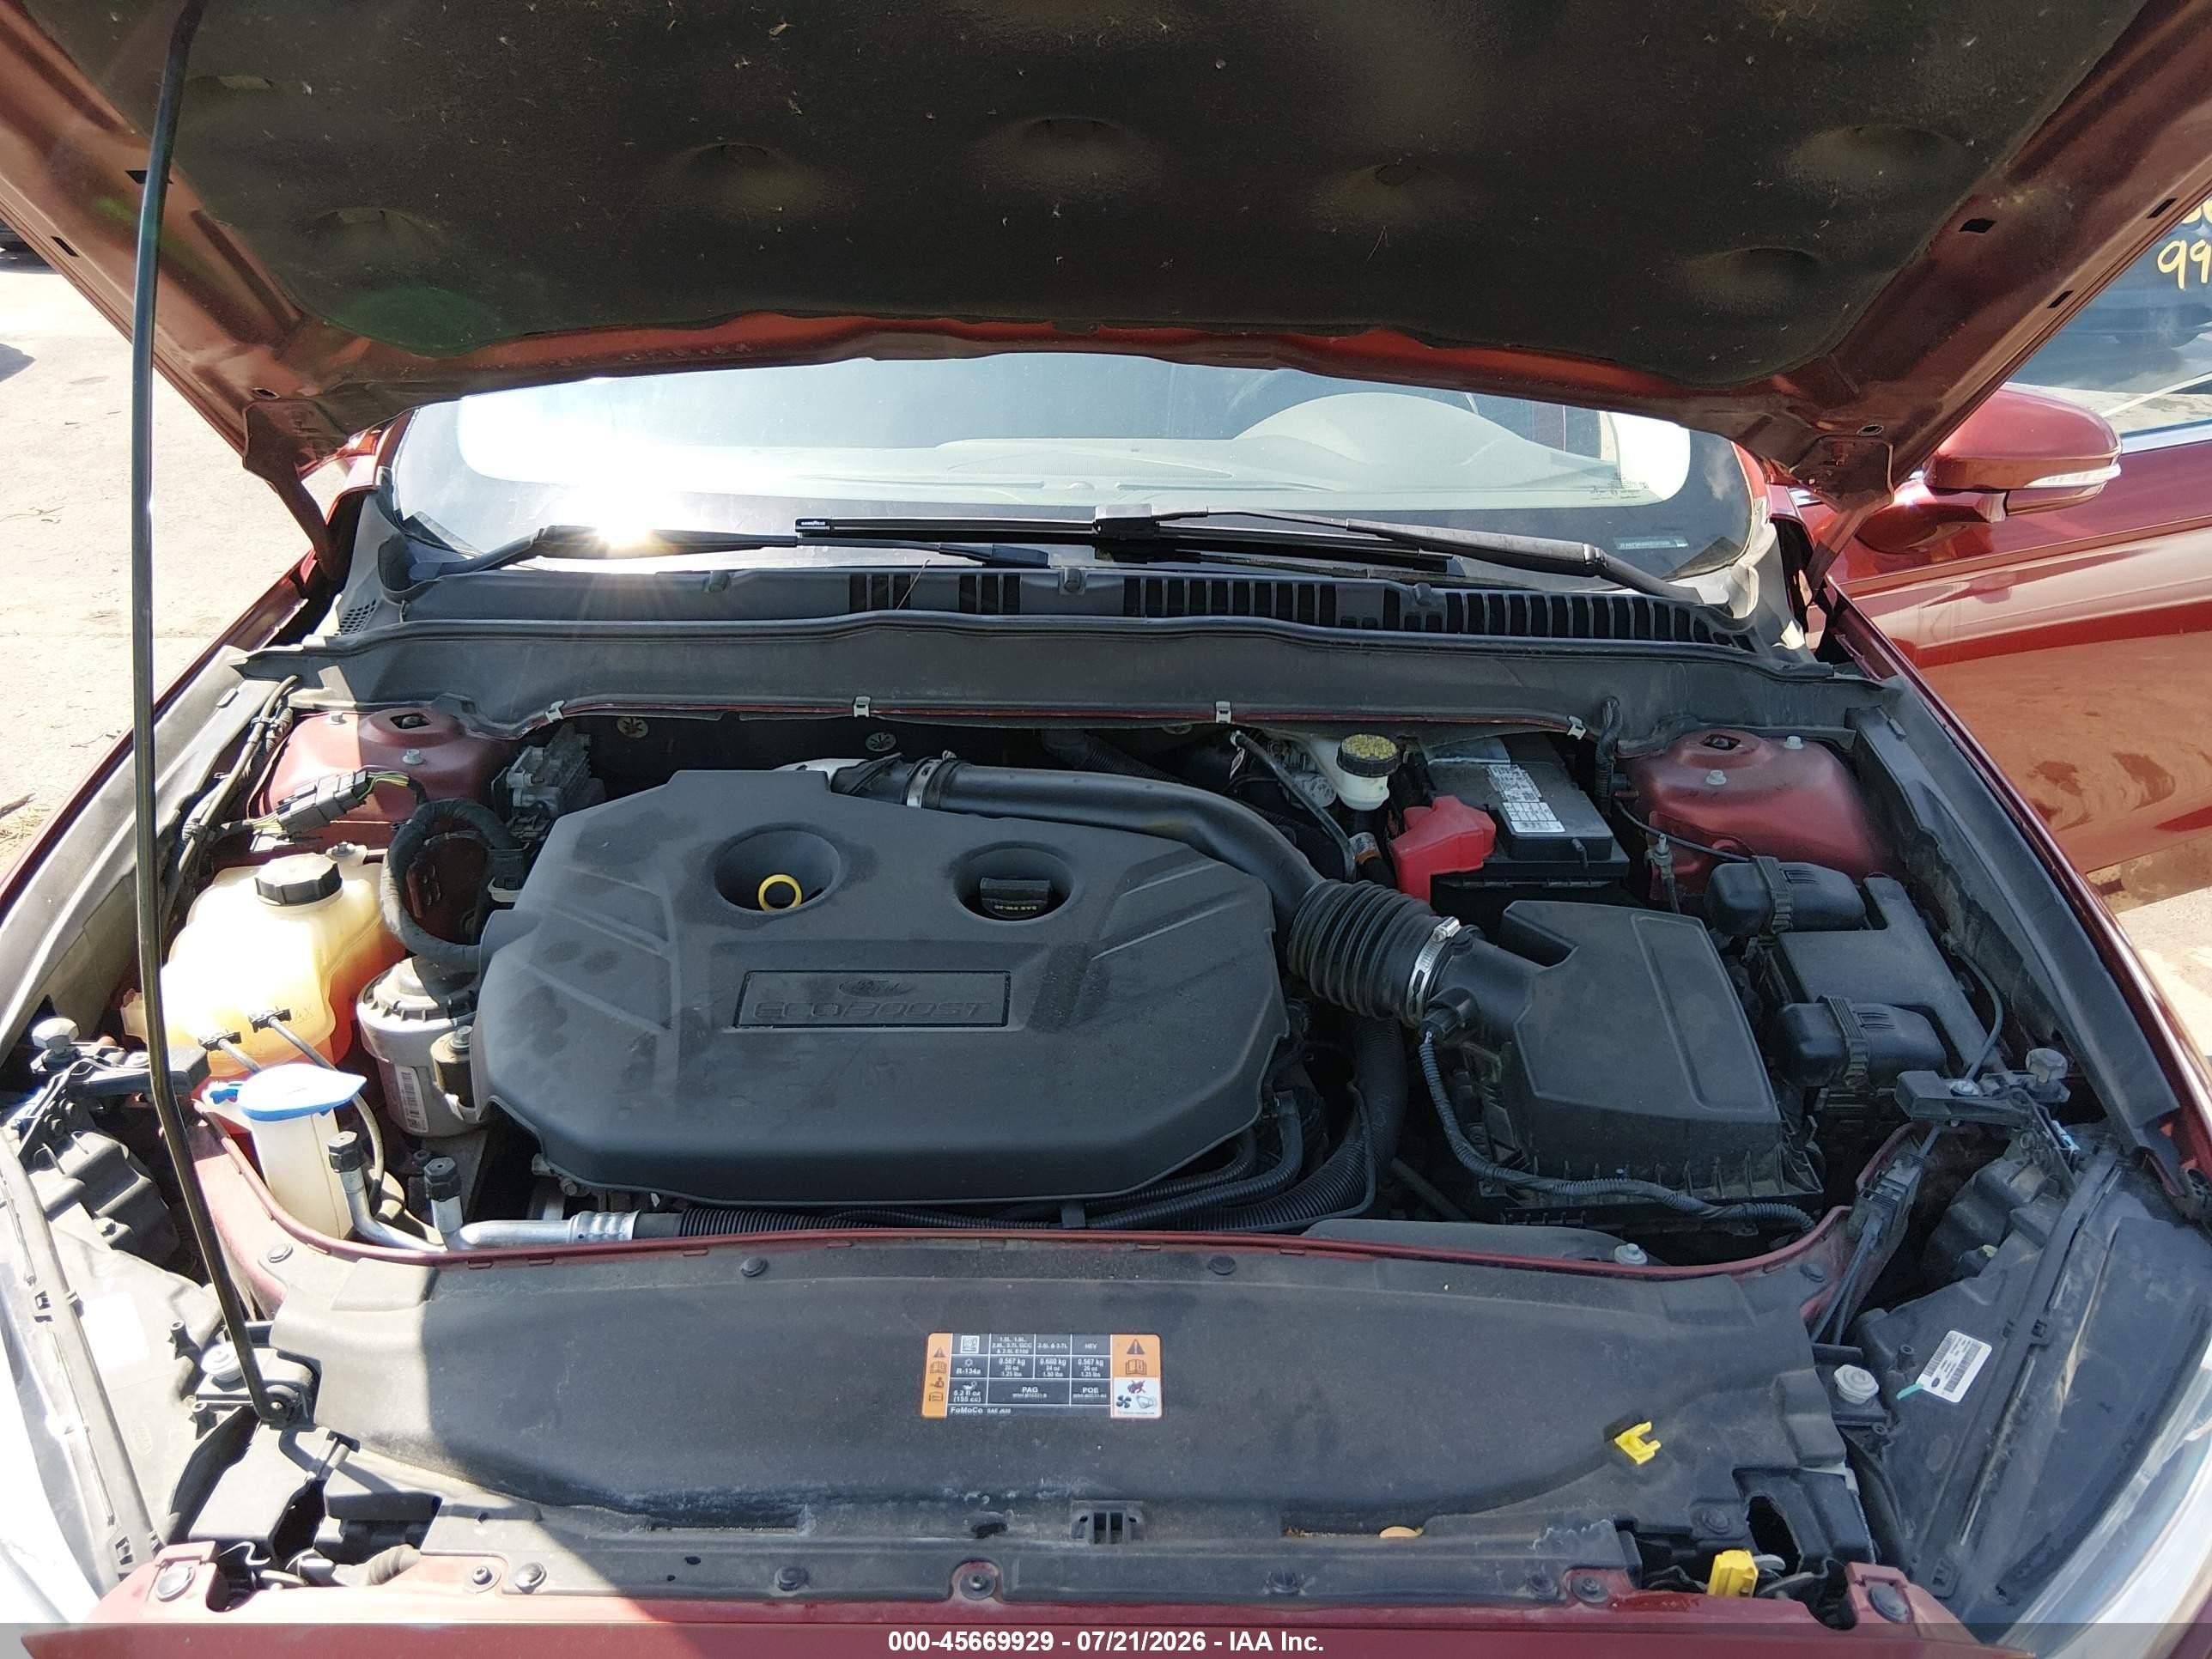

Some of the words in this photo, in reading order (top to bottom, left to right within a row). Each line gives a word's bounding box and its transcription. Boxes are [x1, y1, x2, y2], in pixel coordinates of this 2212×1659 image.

[753, 1001, 994, 1018] ECOBOOST
[1017, 1358, 1026, 1366] kg
[1058, 1358, 1066, 1367] kg
